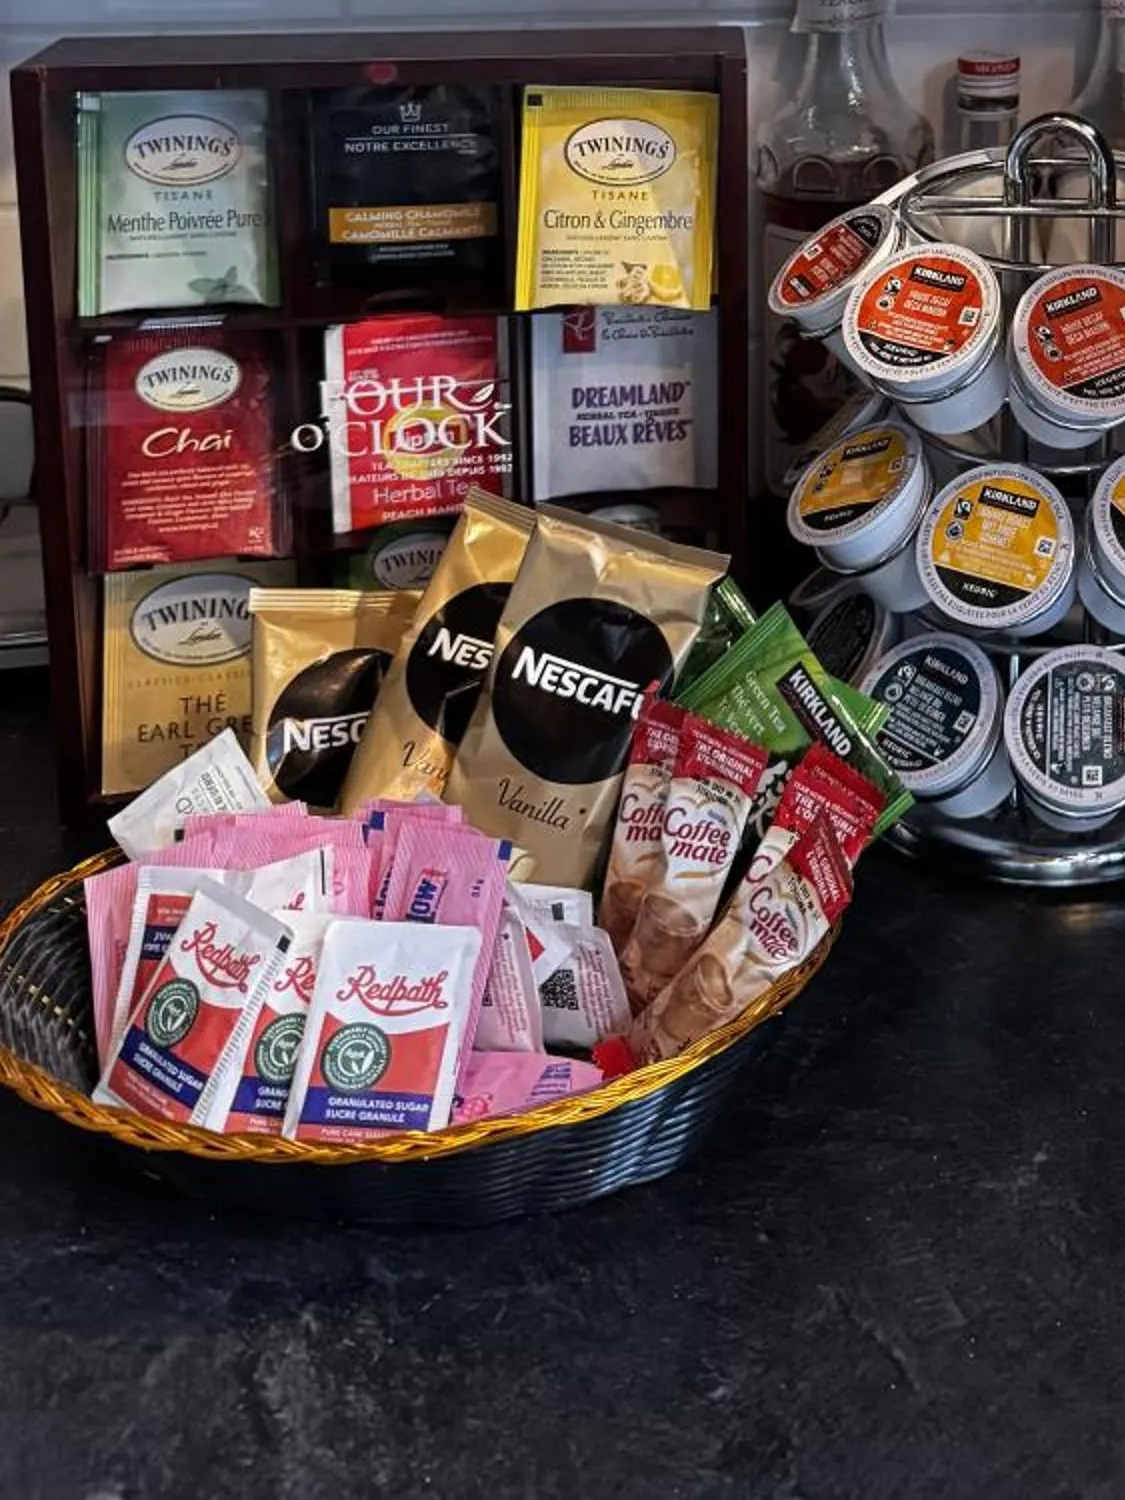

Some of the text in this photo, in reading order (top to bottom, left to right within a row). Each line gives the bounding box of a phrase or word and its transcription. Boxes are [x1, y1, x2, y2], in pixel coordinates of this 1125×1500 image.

[371, 123, 449, 135] OUR FINEST
[133, 135, 232, 159] TWININGS
[345, 140, 478, 153] NOTRE EXCELLENCE
[574, 135, 671, 160] TWININGS
[153, 190, 213, 202] TISANE
[592, 190, 648, 201] TISANE
[107, 209, 263, 233] Menthe Poivrée Pure
[543, 209, 693, 236] Citron & Gingembre
[914, 266, 966, 286] KIRKLAND
[1045, 287, 1098, 313] KIRKLAND
[144, 364, 232, 389] TWININGS
[319, 375, 493, 418] FOUR
[572, 382, 685, 409] DREAMLAND
[576, 411, 616, 421] HERBAL
[142, 428, 233, 457] Chai
[291, 411, 512, 457] O'CLOCK
[569, 418, 688, 448] BEAUX RÊVES
[373, 481, 442, 505] Herbal
[983, 488, 1037, 511] KIRKLAND
[382, 507, 425, 521] PEACH
[961, 581, 1000, 600] KEURIG
[141, 598, 249, 631] TWINING
[924, 654, 970, 685] KIRKLAND
[177, 689, 227, 714] THÉ
[745, 670, 771, 709] Green
[789, 669, 851, 756] KIRKLAND
[137, 714, 255, 743] EARL GRE
[283, 711, 369, 751] NESC
[711, 748, 754, 777] ORIGINAL
[498, 776, 571, 830] Vanilla
[620, 793, 665, 824] Coff
[626, 825, 662, 842] ma
[663, 807, 731, 847] Coffee
[668, 840, 728, 865] mate
[750, 887, 799, 950] Coffee
[750, 918, 787, 959] mate
[336, 963, 449, 1017] Redpath
[325, 1109, 356, 1120] SUCRE
[327, 1096, 430, 1112] GRANULATED SUGAR
